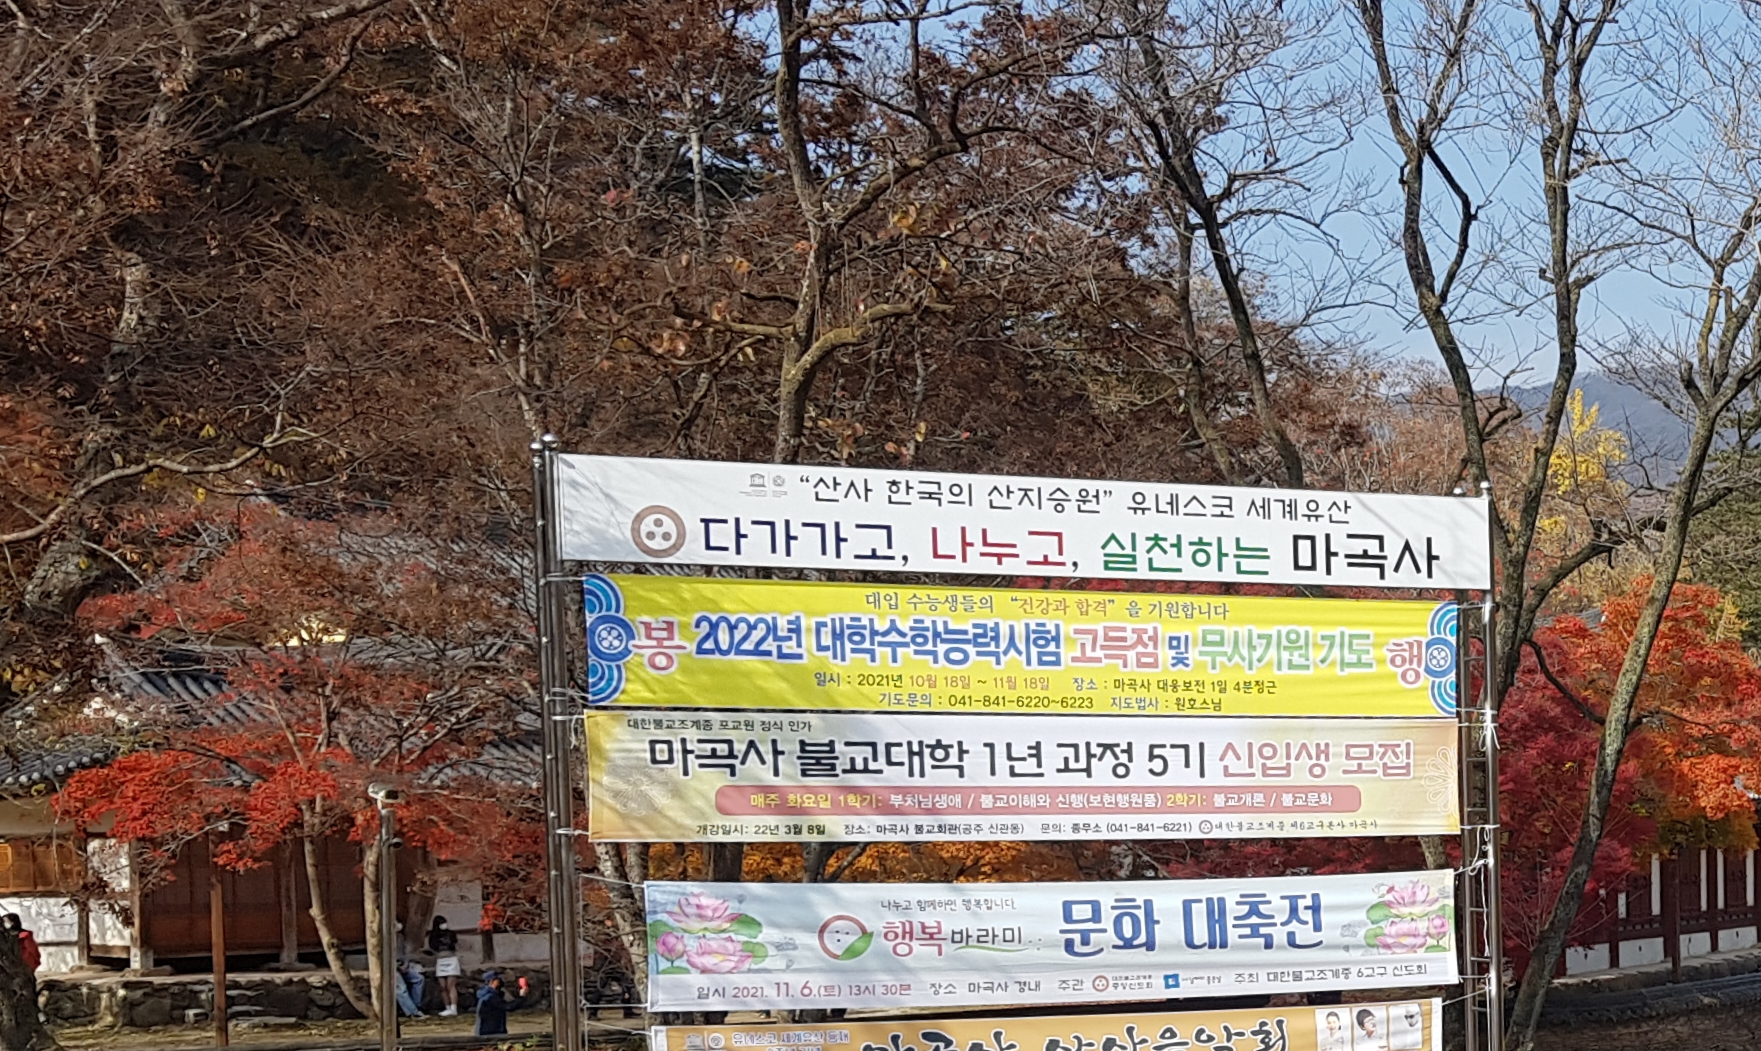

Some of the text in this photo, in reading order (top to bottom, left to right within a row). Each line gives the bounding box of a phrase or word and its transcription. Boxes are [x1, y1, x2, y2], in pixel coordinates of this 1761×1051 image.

[887, 480, 973, 507] 한국의
[1127, 491, 1235, 519] 유네스코
[1246, 496, 1352, 526] 세계유산
[700, 517, 1440, 580] 다가가고, 나누고, 실천하는 마곡사
[865, 591, 899, 610] 대입
[906, 593, 994, 614] 수능생들의
[1125, 601, 1142, 618] 을
[1148, 602, 1230, 621] 기원합니다
[632, 618, 688, 671] 봉
[694, 614, 1374, 671] 2022년 대학수학능력시험 고득점 및 무사기원 기도
[1386, 640, 1423, 685] 행
[814, 672, 841, 687] 일시
[857, 673, 903, 688] 2021년
[909, 674, 938, 689] 10월
[944, 675, 971, 689] 18일
[993, 676, 1017, 690] 11월
[1023, 677, 1050, 691] 18일
[1072, 676, 1098, 692] 장소
[1113, 678, 1151, 693] 마곡사
[1156, 678, 1206, 694] 대웅보전
[1210, 680, 1228, 694] 1일
[1233, 680, 1277, 695] 4분정근
[879, 692, 932, 707] 기도문의
[948, 694, 1094, 710] 041-841-6220~6223
[1110, 695, 1159, 711] 지도법사
[1174, 697, 1222, 712] 원호스님
[627, 718, 812, 733] 대한불교조계종 포교원 정식 인가
[648, 737, 1411, 779] 마곡사 불교대학 1년 과정 5기 신입생 모집
[750, 793, 780, 808] 매주
[786, 793, 832, 809] 화요일
[889, 793, 962, 809] 부처님생애
[979, 793, 1051, 809] 불교이해와
[1213, 793, 1266, 807] 불교개론
[1281, 792, 1333, 807] 불교문화
[754, 824, 779, 835] 22년
[784, 824, 803, 835] 3월
[807, 824, 826, 835] 8일
[876, 824, 909, 835] 마곡사
[1071, 822, 1102, 834] 종무소
[881, 899, 913, 911] 나누고
[1059, 898, 1160, 957] 문화
[1182, 893, 1323, 950] 대축전
[1234, 972, 1259, 984] 주최
[1357, 966, 1387, 978] 6교구
[1392, 964, 1427, 977] 신도회
[697, 986, 725, 999] 일시
[849, 984, 875, 996] 13시
[881, 984, 911, 996] 30분
[929, 982, 957, 995] 장소
[968, 981, 1009, 994] 마곡사
[1014, 980, 1041, 993] 경내
[1058, 979, 1084, 991] 주관
[733, 1032, 777, 1045] 유네스코
